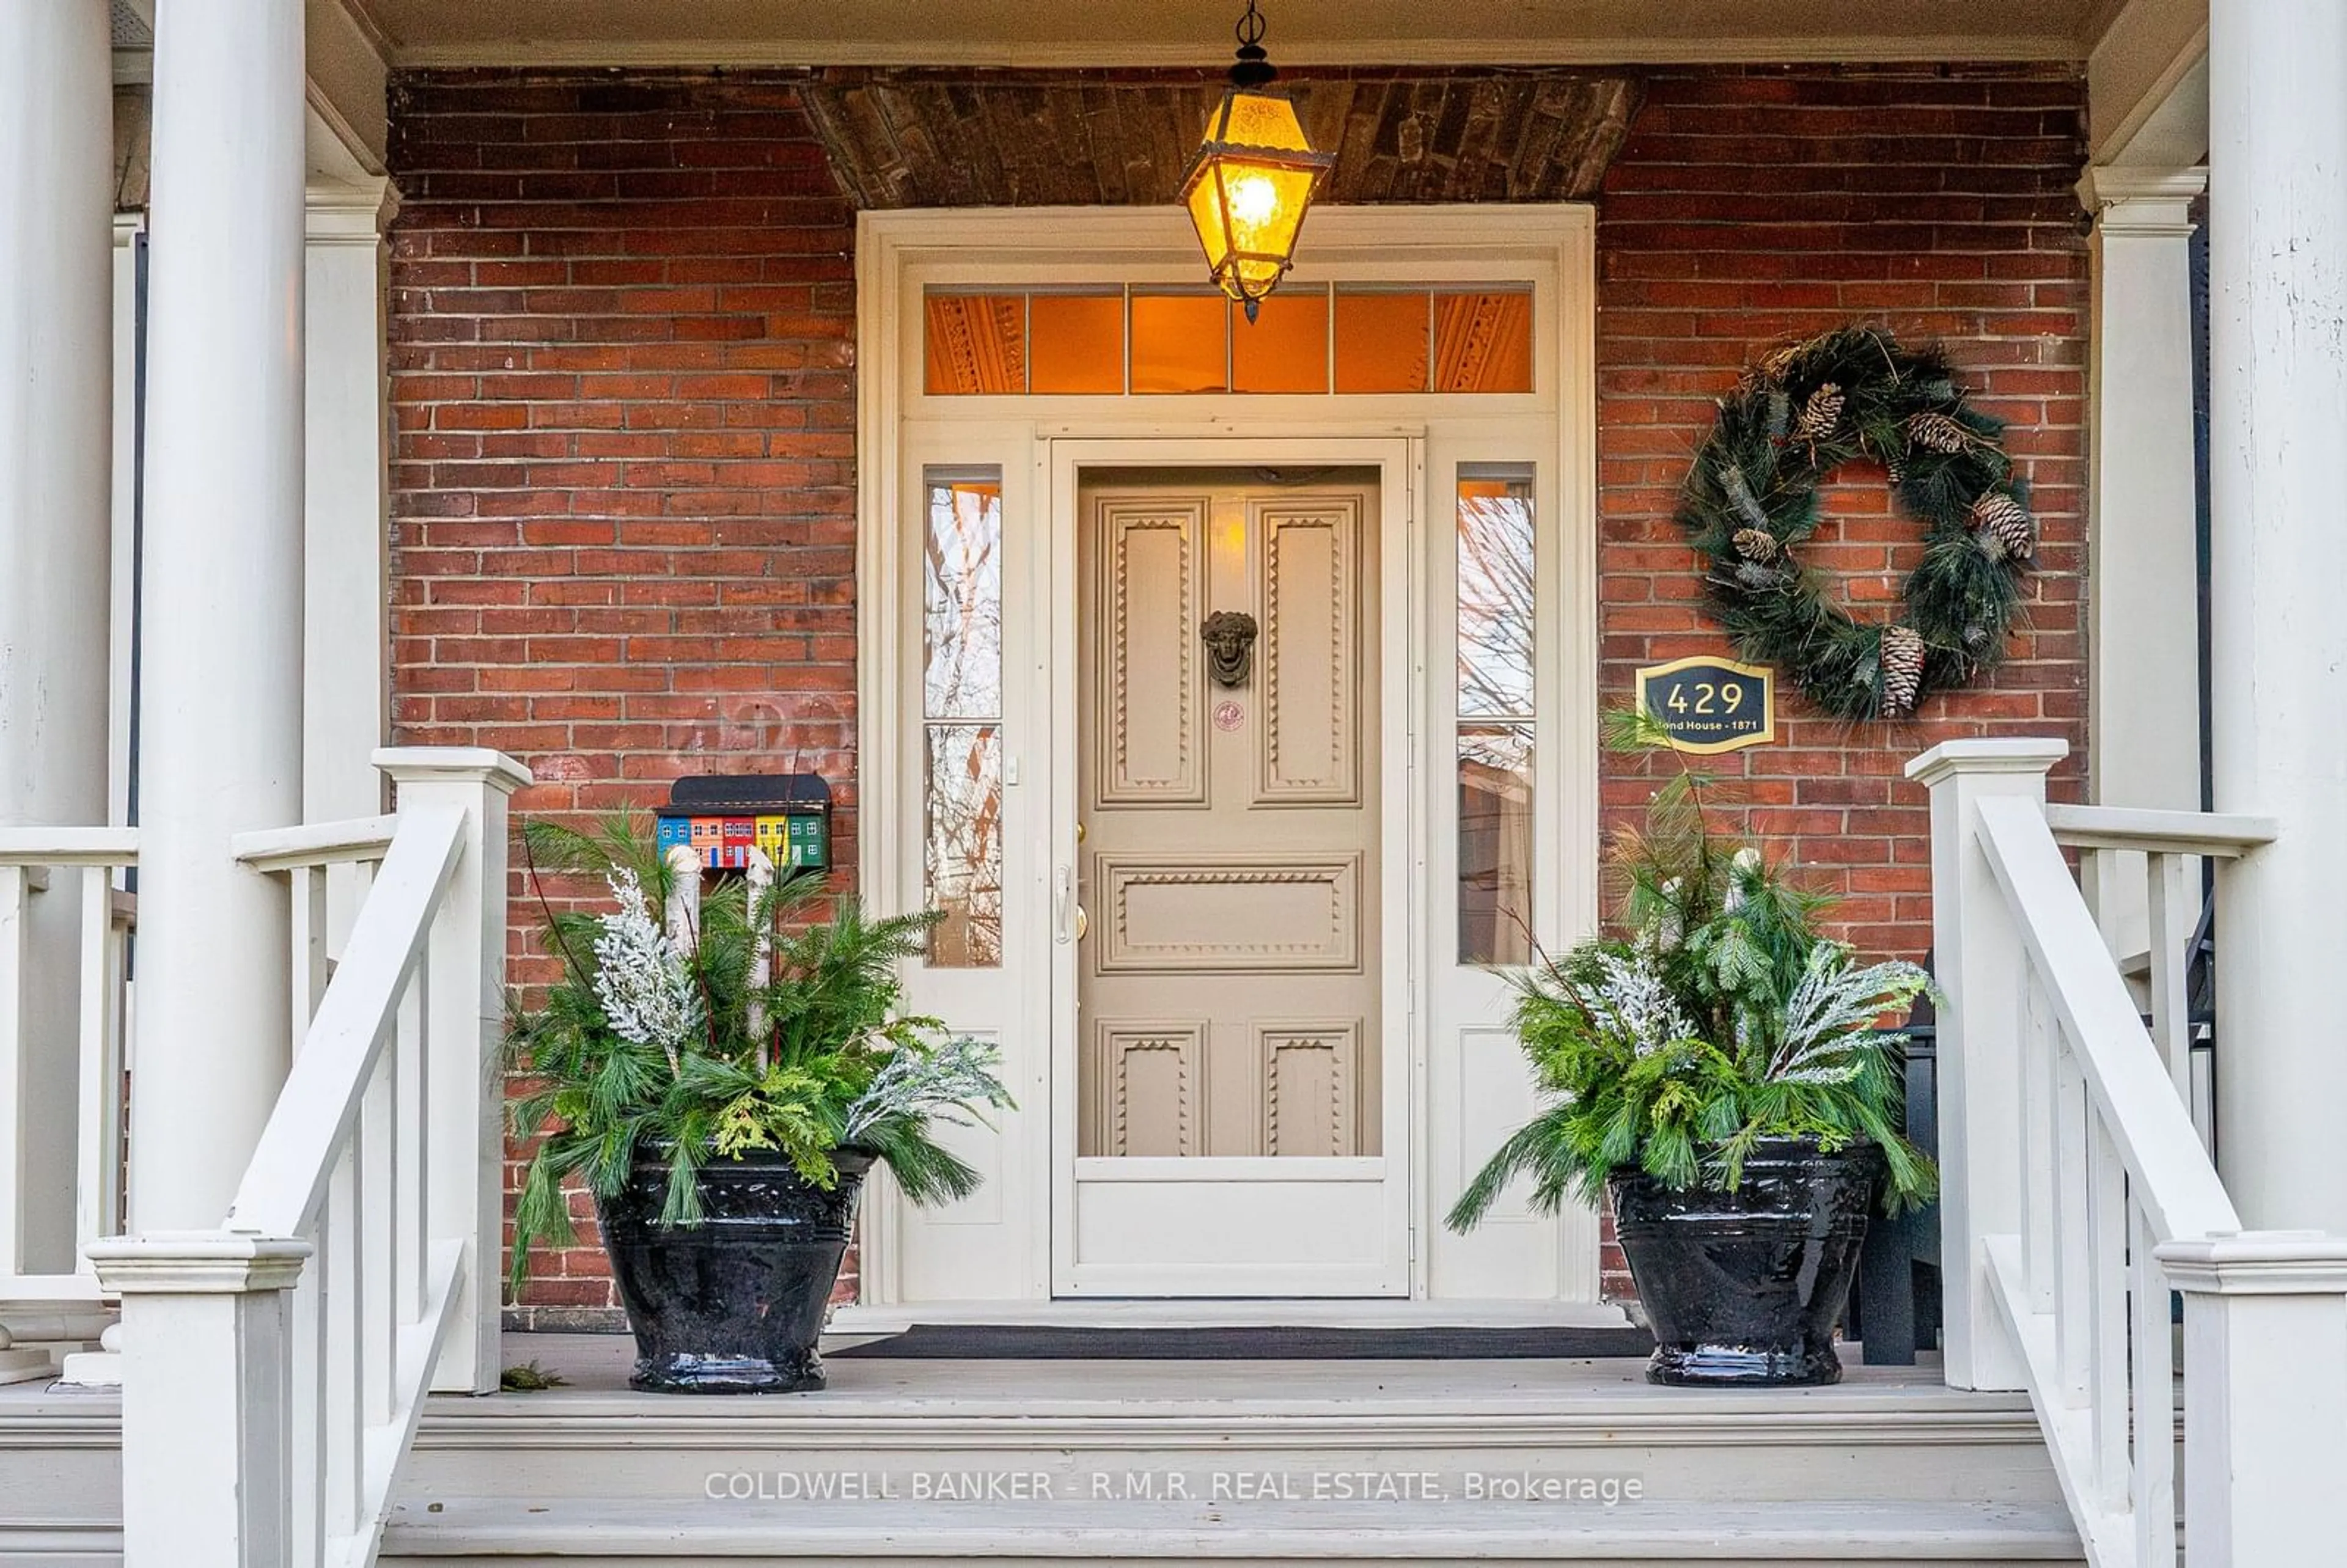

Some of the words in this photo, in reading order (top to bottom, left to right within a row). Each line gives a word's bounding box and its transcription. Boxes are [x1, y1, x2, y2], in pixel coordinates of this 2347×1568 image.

[1667, 683, 1743, 714] 429
[1686, 720, 1722, 730] House
[1732, 720, 1757, 730] 1871
